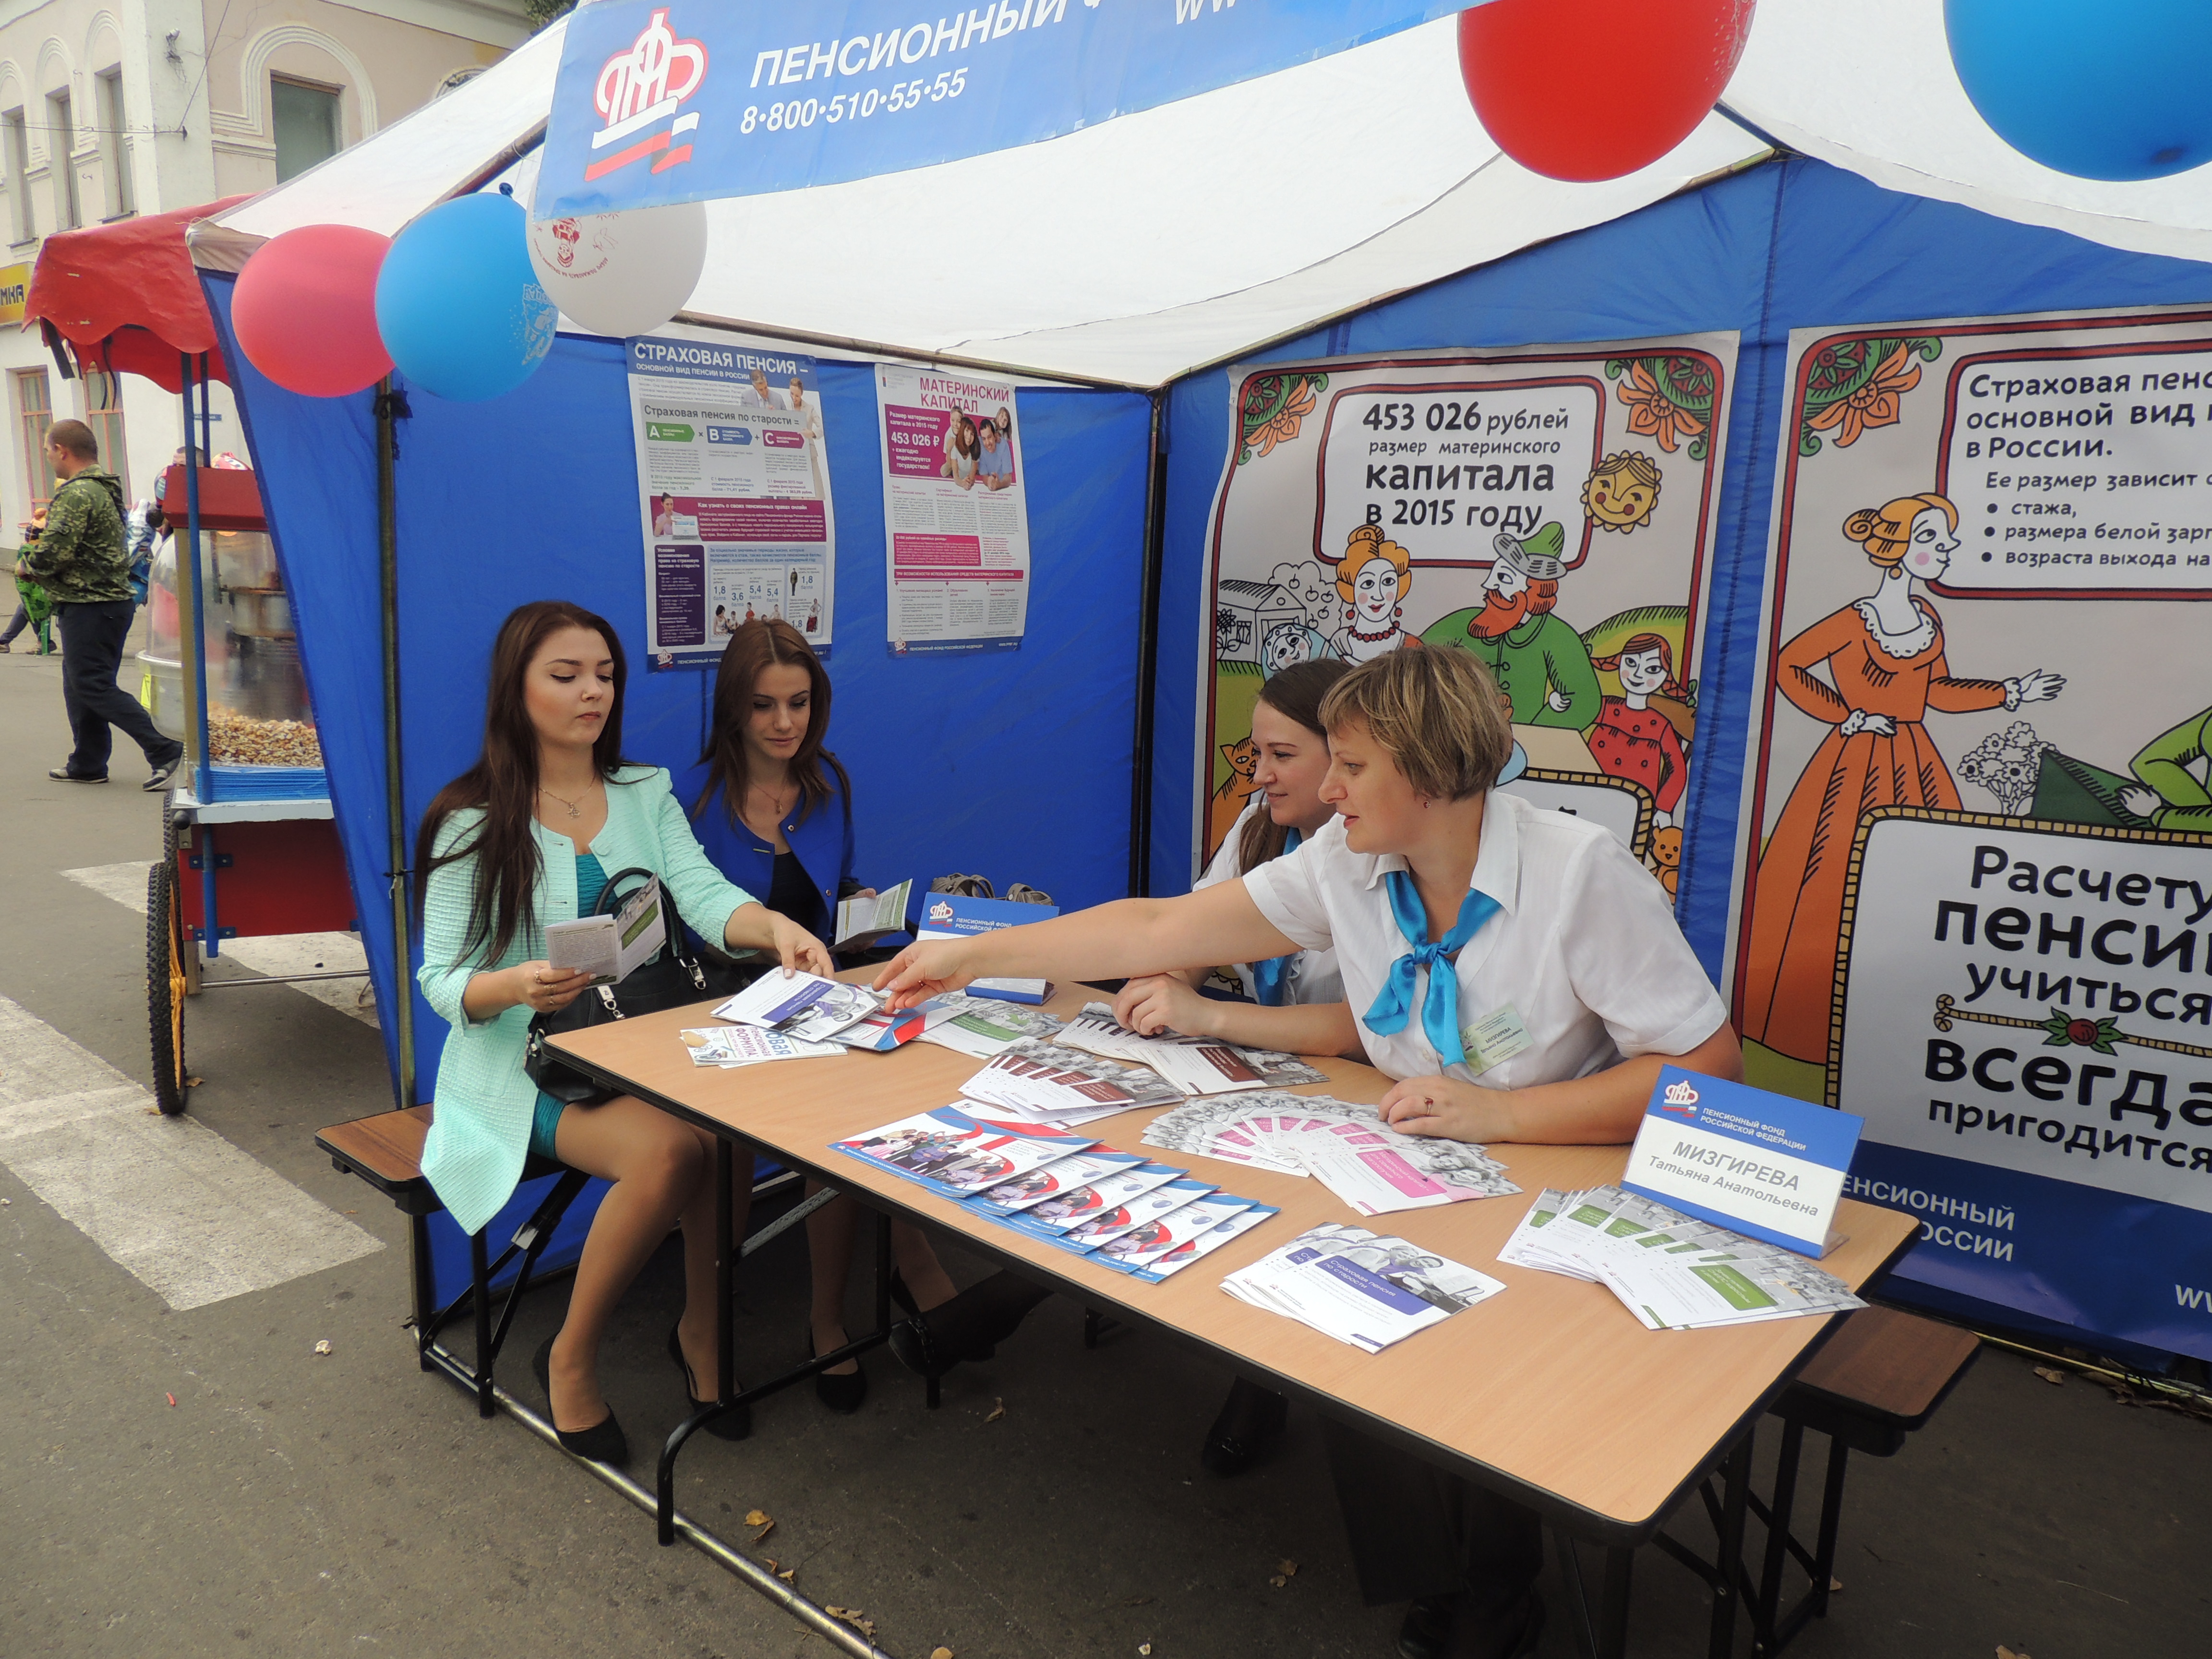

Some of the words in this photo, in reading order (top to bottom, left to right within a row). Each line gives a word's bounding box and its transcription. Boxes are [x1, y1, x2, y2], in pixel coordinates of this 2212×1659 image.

[635, 342, 733, 368] СТРАХОВАЯ
[736, 354, 797, 375] ПЕНСИЯ
[636, 362, 674, 373] ОСНОВНОЙ
[676, 367, 690, 375] ВИД
[691, 368, 718, 377] ПЕНСИИ
[725, 372, 750, 381] РОССИИ
[920, 377, 1010, 402] МАТЕРИНСКИЙ
[1970, 373, 2130, 402] Страховая
[921, 393, 978, 413] КАПИТАЛ
[644, 404, 698, 419] Страховая
[701, 410, 735, 421] пенсия
[738, 413, 749, 422] по
[752, 414, 792, 426] старости
[890, 411, 907, 420] Размер
[907, 413, 940, 422] материнского
[1362, 402, 1414, 431] 453
[1426, 401, 1481, 432] 026
[1488, 408, 1569, 435] рублей
[1967, 402, 2113, 429] основной
[2130, 403, 2195, 427] вид
[891, 432, 910, 445] 453
[912, 433, 931, 446] 026
[1370, 442, 1427, 456] размер
[1439, 440, 1561, 458] материнского
[1966, 441, 1981, 458] в
[1366, 463, 1554, 492] капитала
[1986, 471, 2011, 489] Ее
[2017, 473, 2097, 492] размер
[2106, 473, 2198, 492] зависит
[1366, 503, 1382, 525] в
[1392, 499, 1455, 526] 2015
[1467, 505, 1542, 535] году
[2011, 503, 2077, 519] стажа,
[2005, 526, 2087, 541] размера
[2094, 522, 2160, 540] белой
[2006, 551, 2093, 567] возраста
[2100, 553, 2176, 568] выхода
[2187, 553, 2210, 566] на
[714, 586, 726, 595] 1,8
[749, 585, 761, 594] 5,4
[802, 576, 813, 585] 1,8
[732, 592, 744, 602] 3,6
[767, 588, 779, 598] 5,4
[1971, 845, 2212, 926] Расчету
[955, 924, 992, 932] РОССИЙСКОЙ
[956, 918, 995, 926] ПЕНСИОННЫЙ
[1935, 900, 2212, 976] пенси
[1964, 963, 2212, 1025] учиться
[749, 1027, 771, 1057] пенсионная
[1700, 1116, 1755, 1136] РОССИЙСКОЙ
[1756, 1131, 1806, 1151] ФЕДЕРАЦИИ
[1703, 1107, 1760, 1129] ПЕНСИОННЫЙ
[1761, 1123, 1786, 1137] ФОНД
[1929, 1100, 2212, 1173] пригодится
[1672, 1141, 1799, 1191] МИЗГИРЕВА
[1649, 1155, 1710, 1184] Татьяна
[1713, 1176, 1819, 1216] Анатольевна
[1841, 1174, 2015, 1231] ЕНСИОННЫЙ
[1921, 1221, 2013, 1262] ОССИИ
[1331, 1260, 1369, 1283] Страховая
[1369, 1281, 1396, 1297] пенсия
[1334, 1268, 1368, 1289] старости
